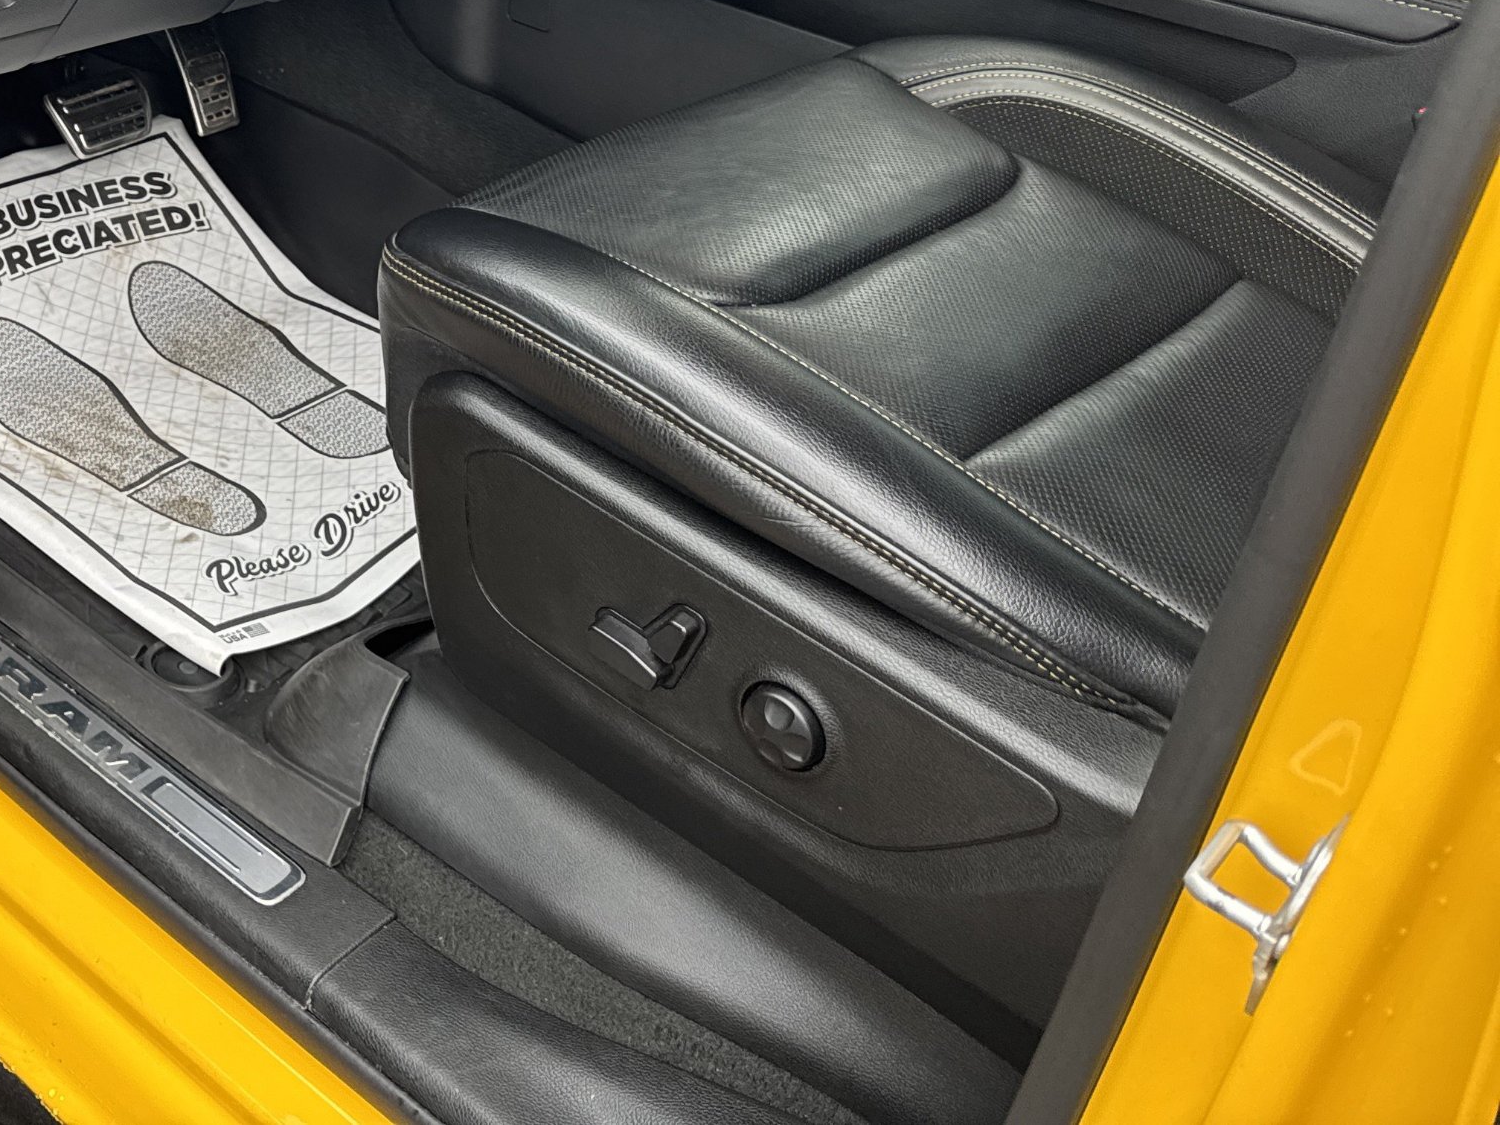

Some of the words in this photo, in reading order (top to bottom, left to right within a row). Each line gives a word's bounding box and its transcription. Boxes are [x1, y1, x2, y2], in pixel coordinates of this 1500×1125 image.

[205, 543, 311, 596] Please
[313, 481, 401, 558] Drive
[222, 633, 248, 644] USA
